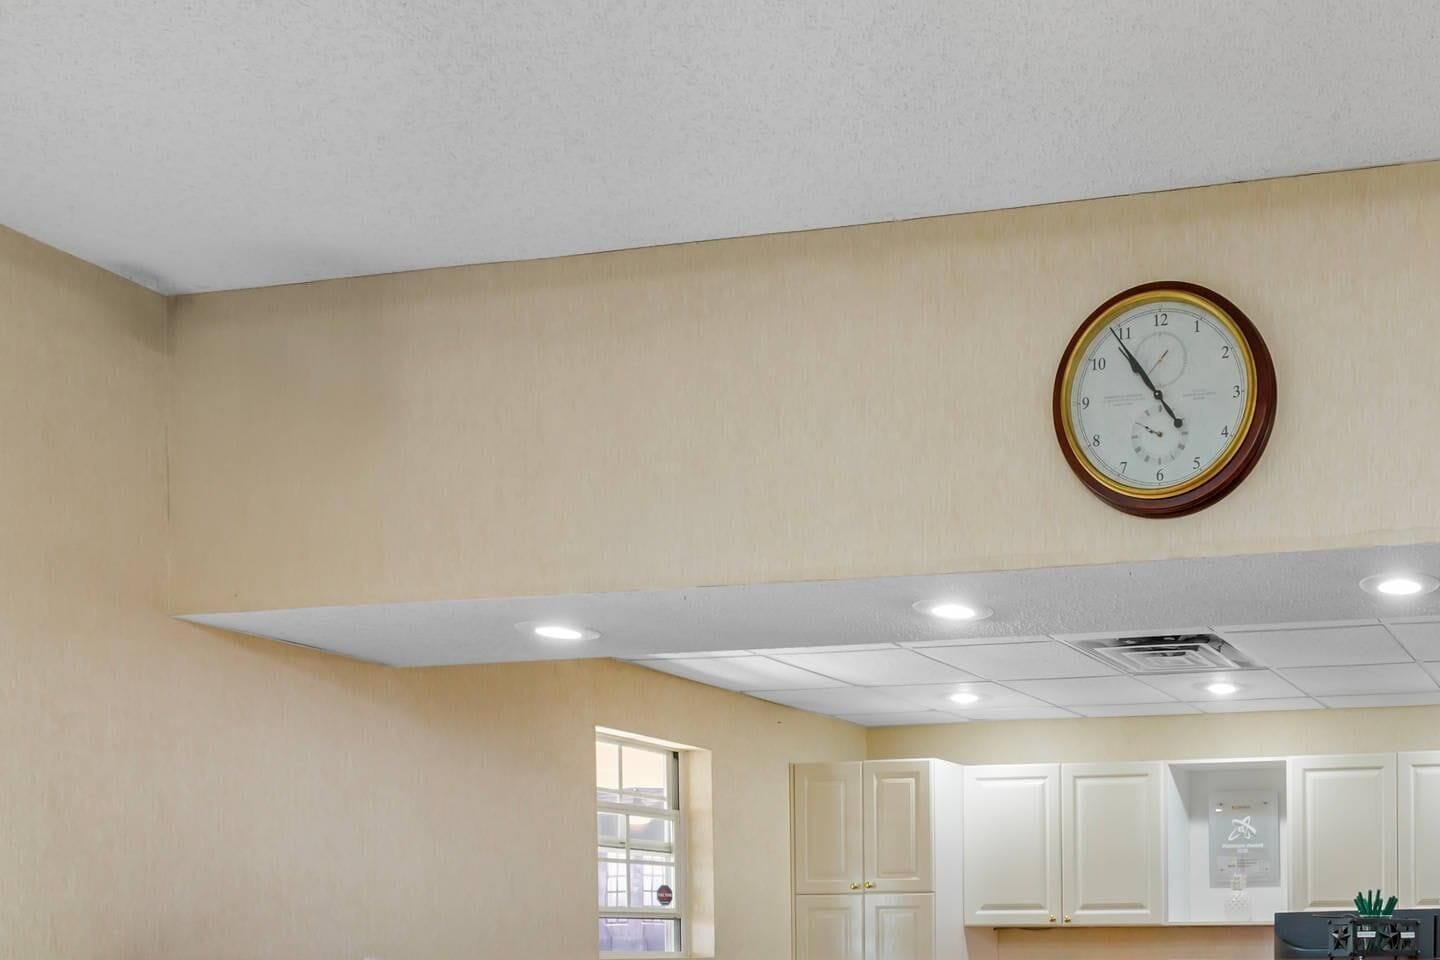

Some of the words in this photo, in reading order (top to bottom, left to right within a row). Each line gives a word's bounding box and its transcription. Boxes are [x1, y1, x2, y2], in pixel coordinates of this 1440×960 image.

[1153, 313, 1168, 327] 12
[1194, 320, 1200, 333] 1
[1119, 327, 1131, 340] 11
[1221, 346, 1229, 359] 2
[1092, 358, 1106, 371] 10
[1232, 385, 1241, 398] 3
[1081, 396, 1090, 410] 9
[1221, 425, 1229, 438] 4
[1092, 434, 1101, 447] 8
[1119, 461, 1128, 474] 7
[1193, 457, 1201, 470] 5
[1156, 469, 1164, 481] 6
